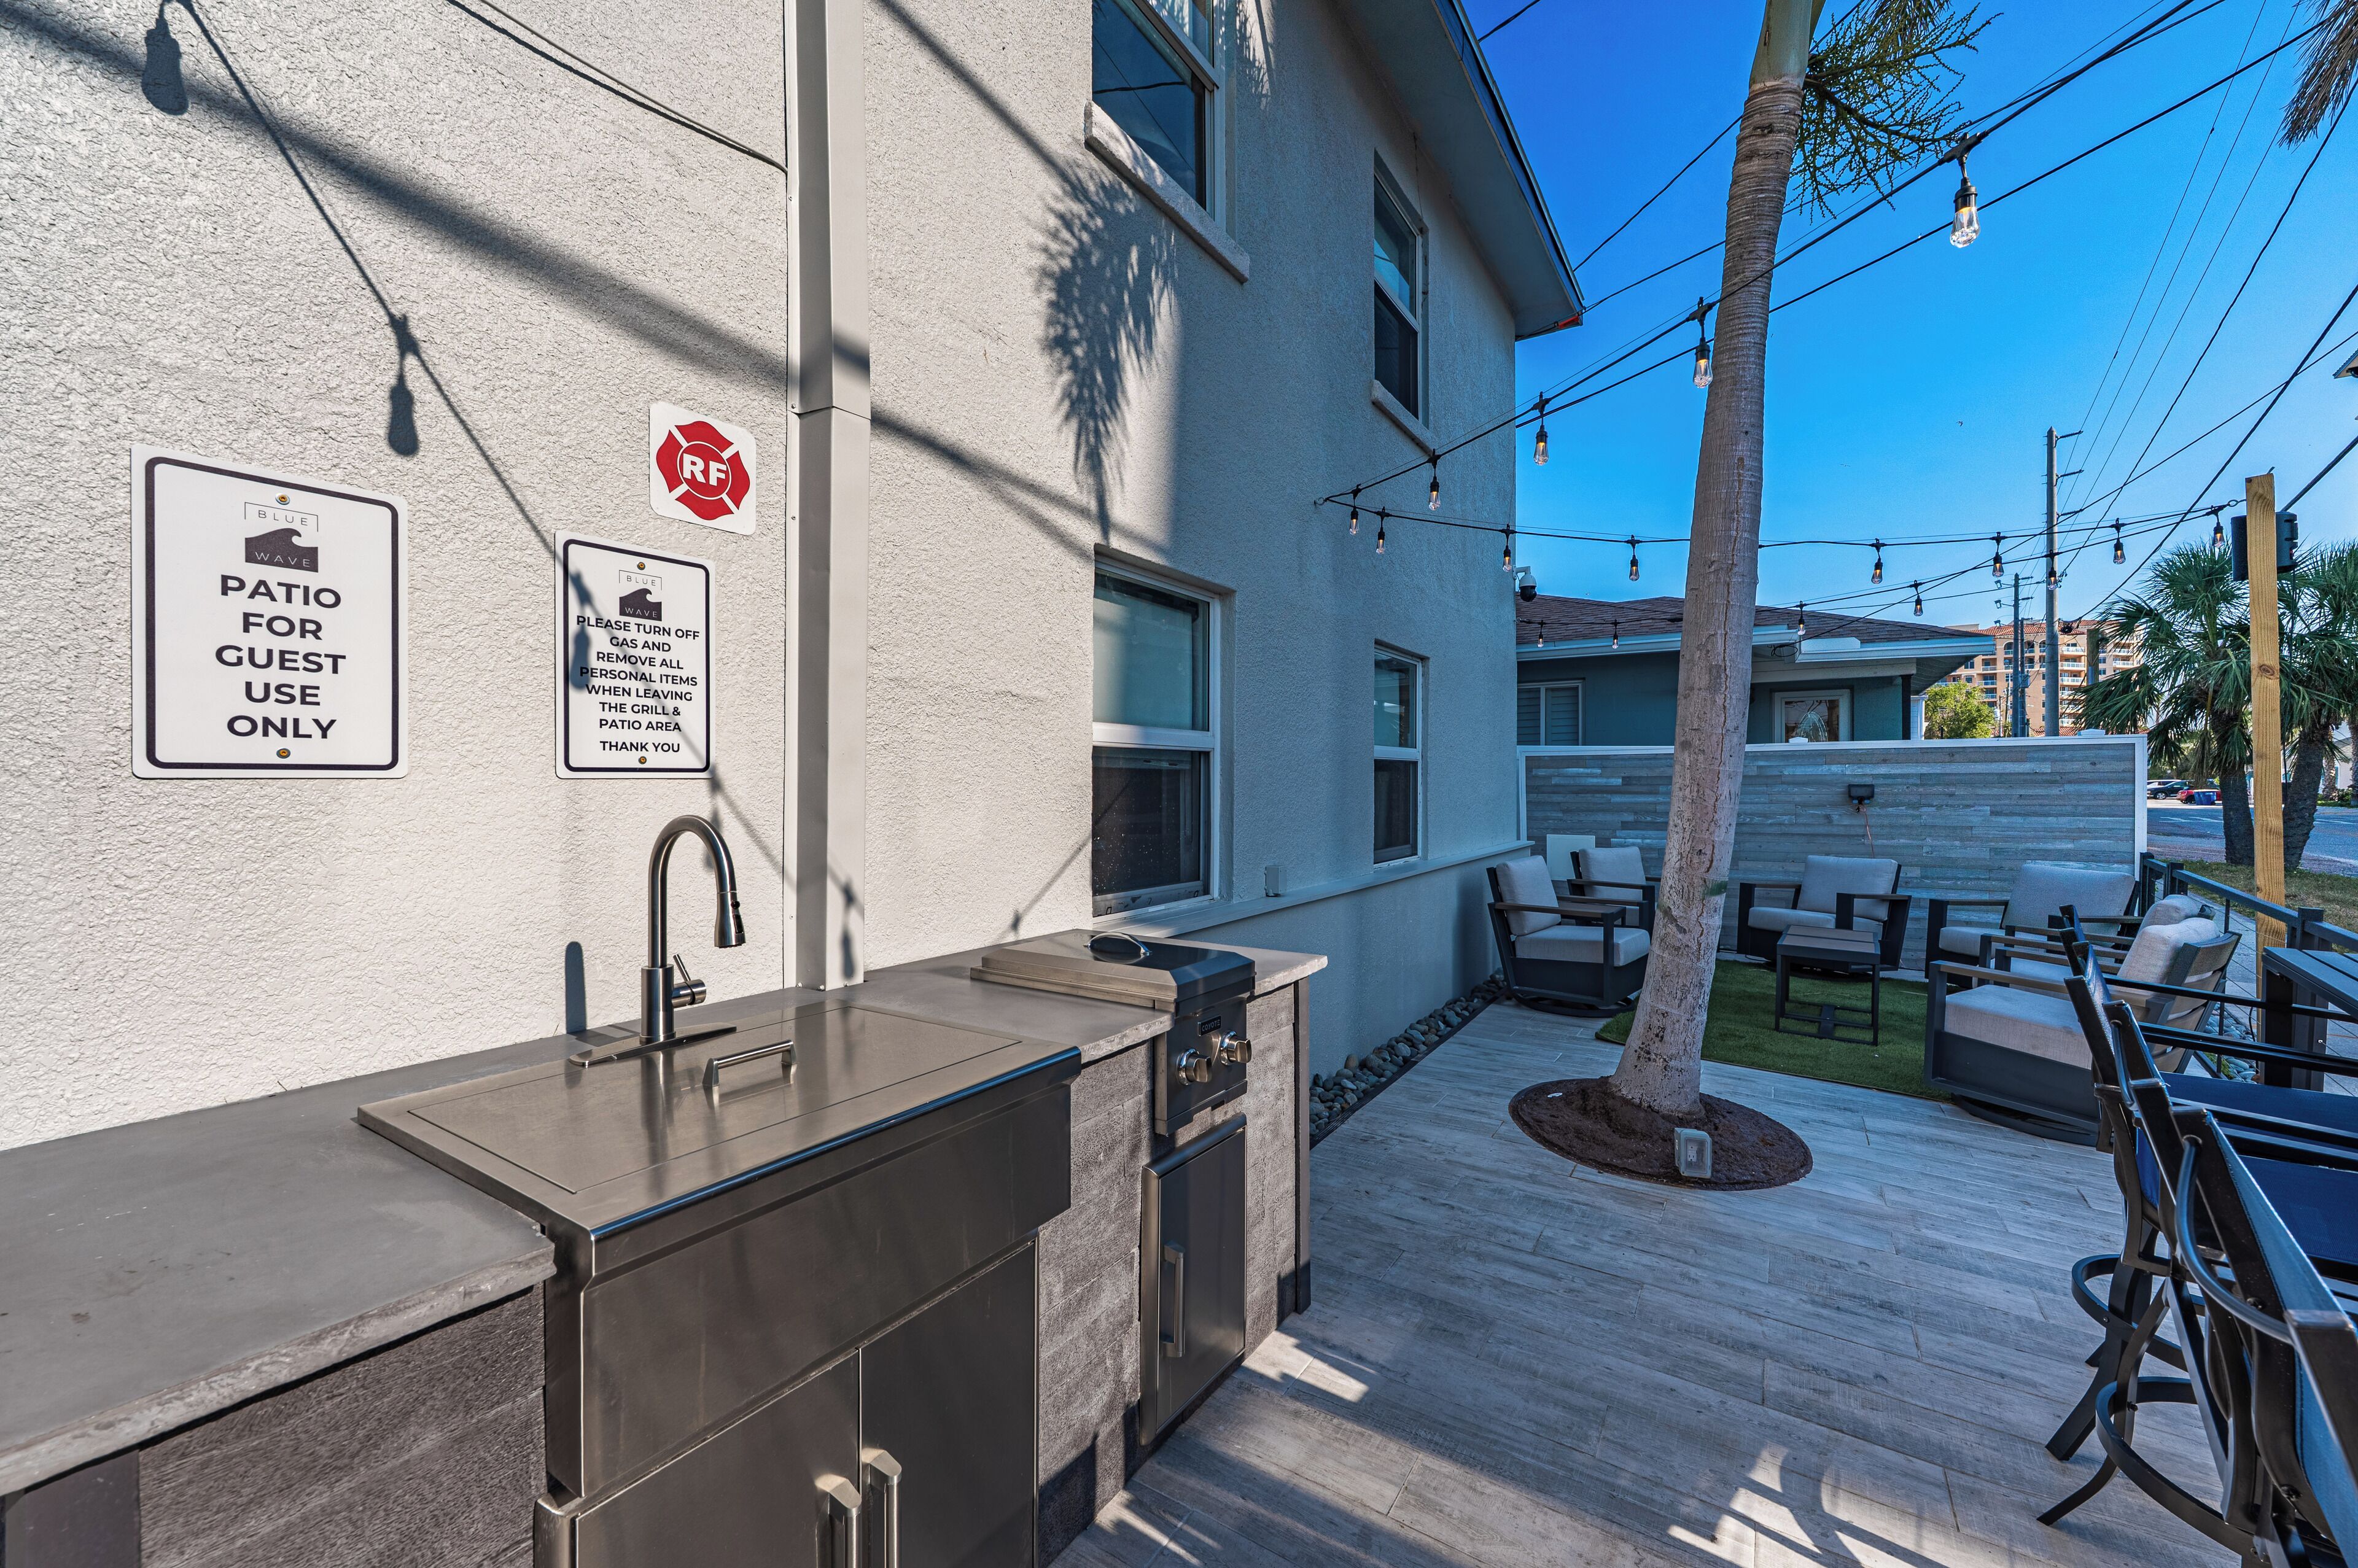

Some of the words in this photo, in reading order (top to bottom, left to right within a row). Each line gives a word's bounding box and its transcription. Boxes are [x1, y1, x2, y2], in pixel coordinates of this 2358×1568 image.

[683, 452, 727, 487] RF
[258, 510, 308, 526] BLUE
[255, 551, 310, 567] WAVE
[626, 575, 656, 586] BLUE
[220, 574, 341, 608] PATIO
[625, 607, 658, 618] WAVE
[243, 611, 322, 640] FOR
[576, 615, 631, 632] PLEASE
[634, 623, 671, 637] TURN
[675, 629, 700, 640] OFF
[610, 636, 638, 649] GAS
[641, 640, 671, 652] AND
[215, 645, 346, 674] GUEST
[597, 651, 656, 667] REMOVE
[660, 658, 683, 670] ALL
[579, 666, 656, 683] PERSONAL
[660, 673, 698, 686] ITEMS
[245, 681, 321, 706] USE
[585, 683, 631, 697] WHEN
[636, 688, 693, 701] LEAVING
[599, 702, 627, 713] THE
[631, 704, 669, 716] GRILL
[672, 707, 681, 716] &
[227, 715, 337, 739] ONLY
[599, 718, 642, 730] PATIO
[645, 721, 682, 732] AREA
[599, 741, 649, 752] THANK
[652, 742, 680, 753] YOU
[1202, 1019, 1220, 1031] COYOTE
